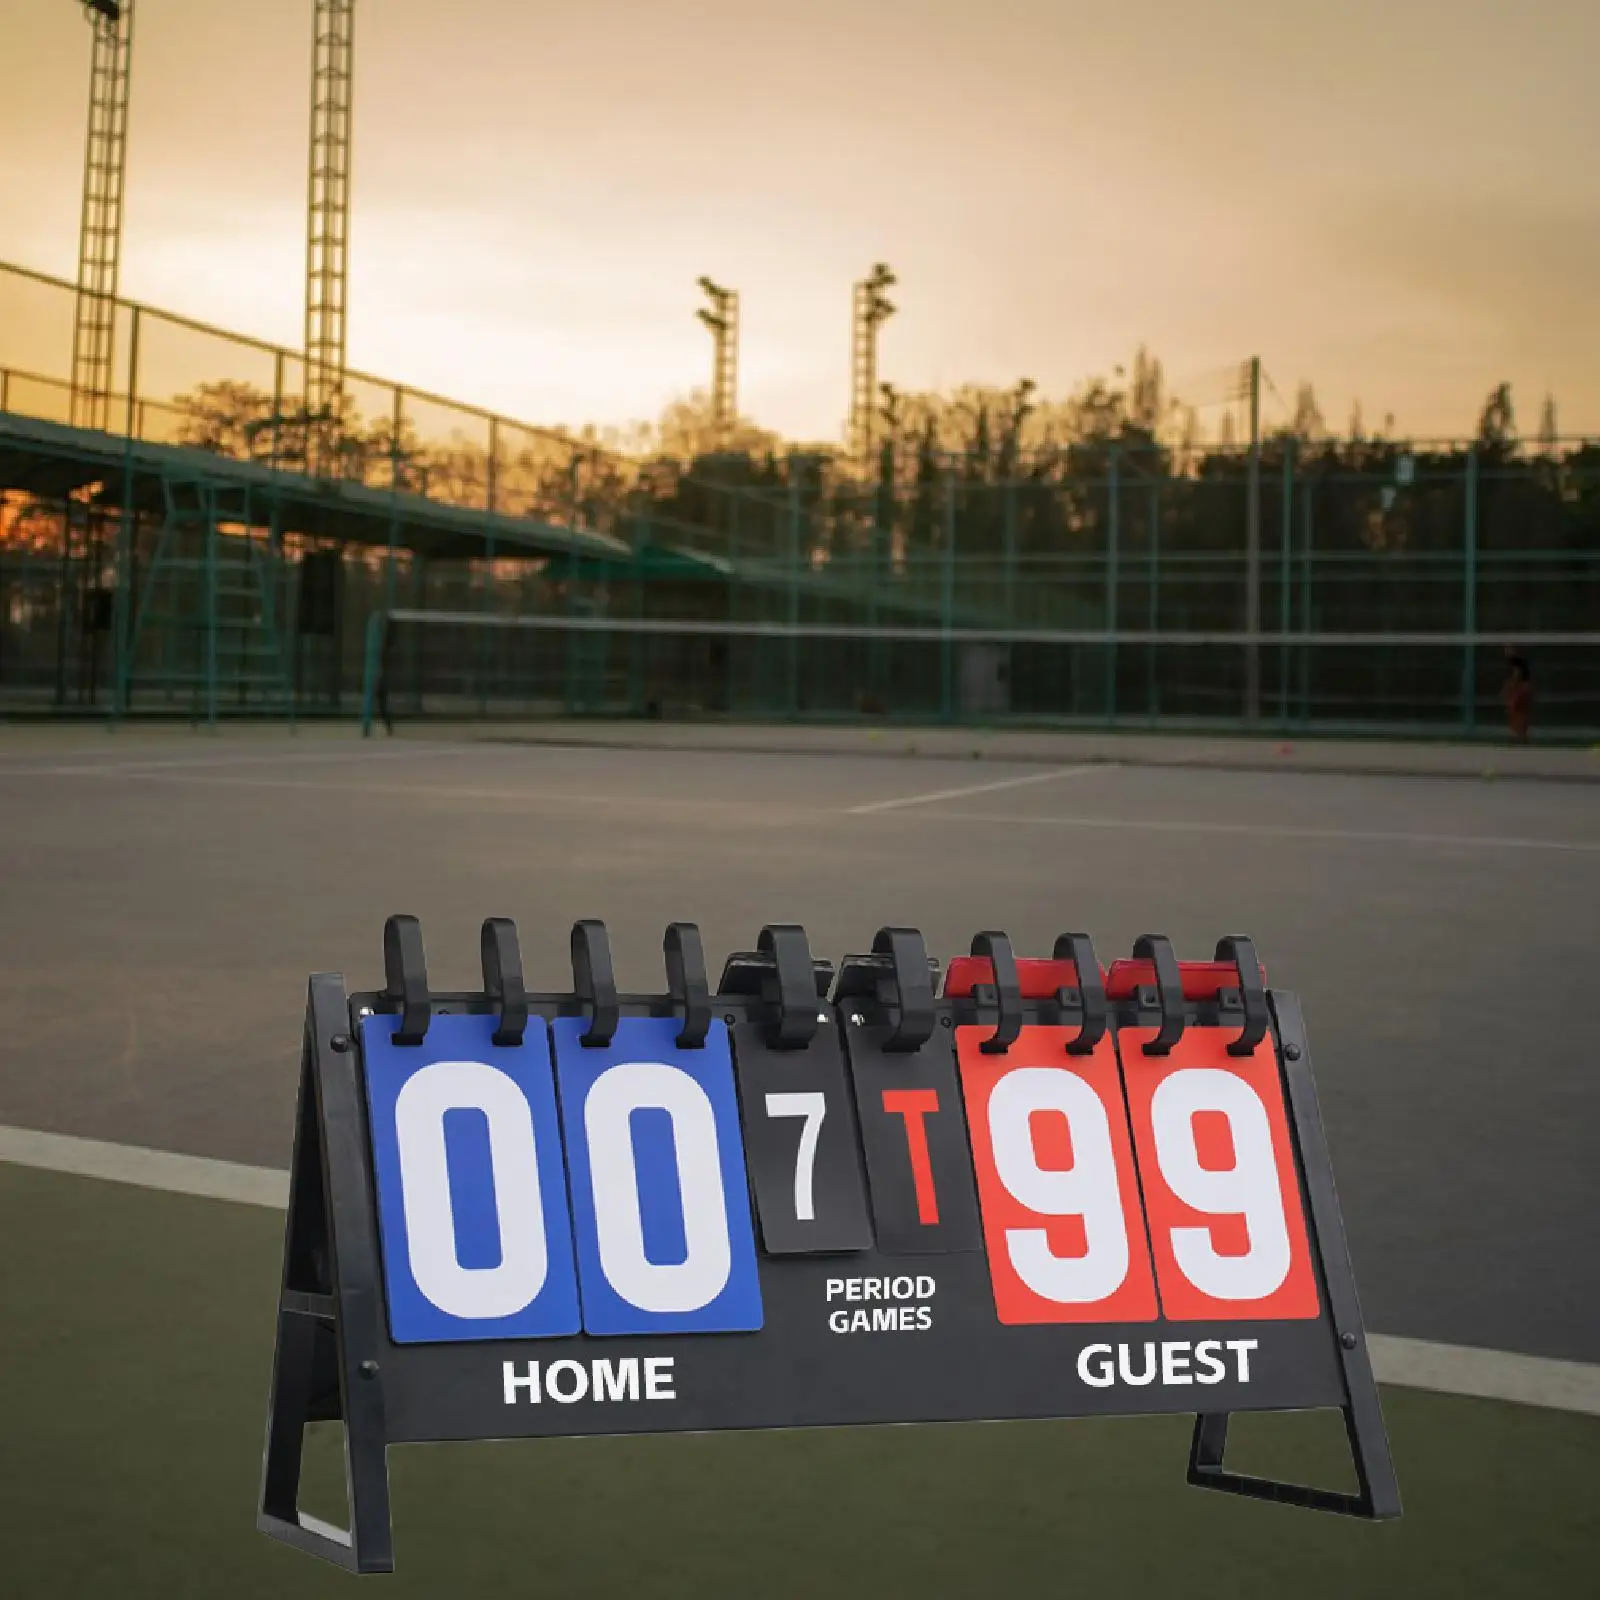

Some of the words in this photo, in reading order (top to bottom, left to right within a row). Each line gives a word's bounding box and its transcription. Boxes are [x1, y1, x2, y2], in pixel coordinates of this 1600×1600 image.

[764, 1092, 826, 1221] 7
[882, 1089, 940, 1225] T
[825, 1276, 936, 1302] PERIOD
[828, 1306, 933, 1333] GAMES
[502, 1357, 677, 1404] HOME
[1076, 1339, 1258, 1388] GUEST
